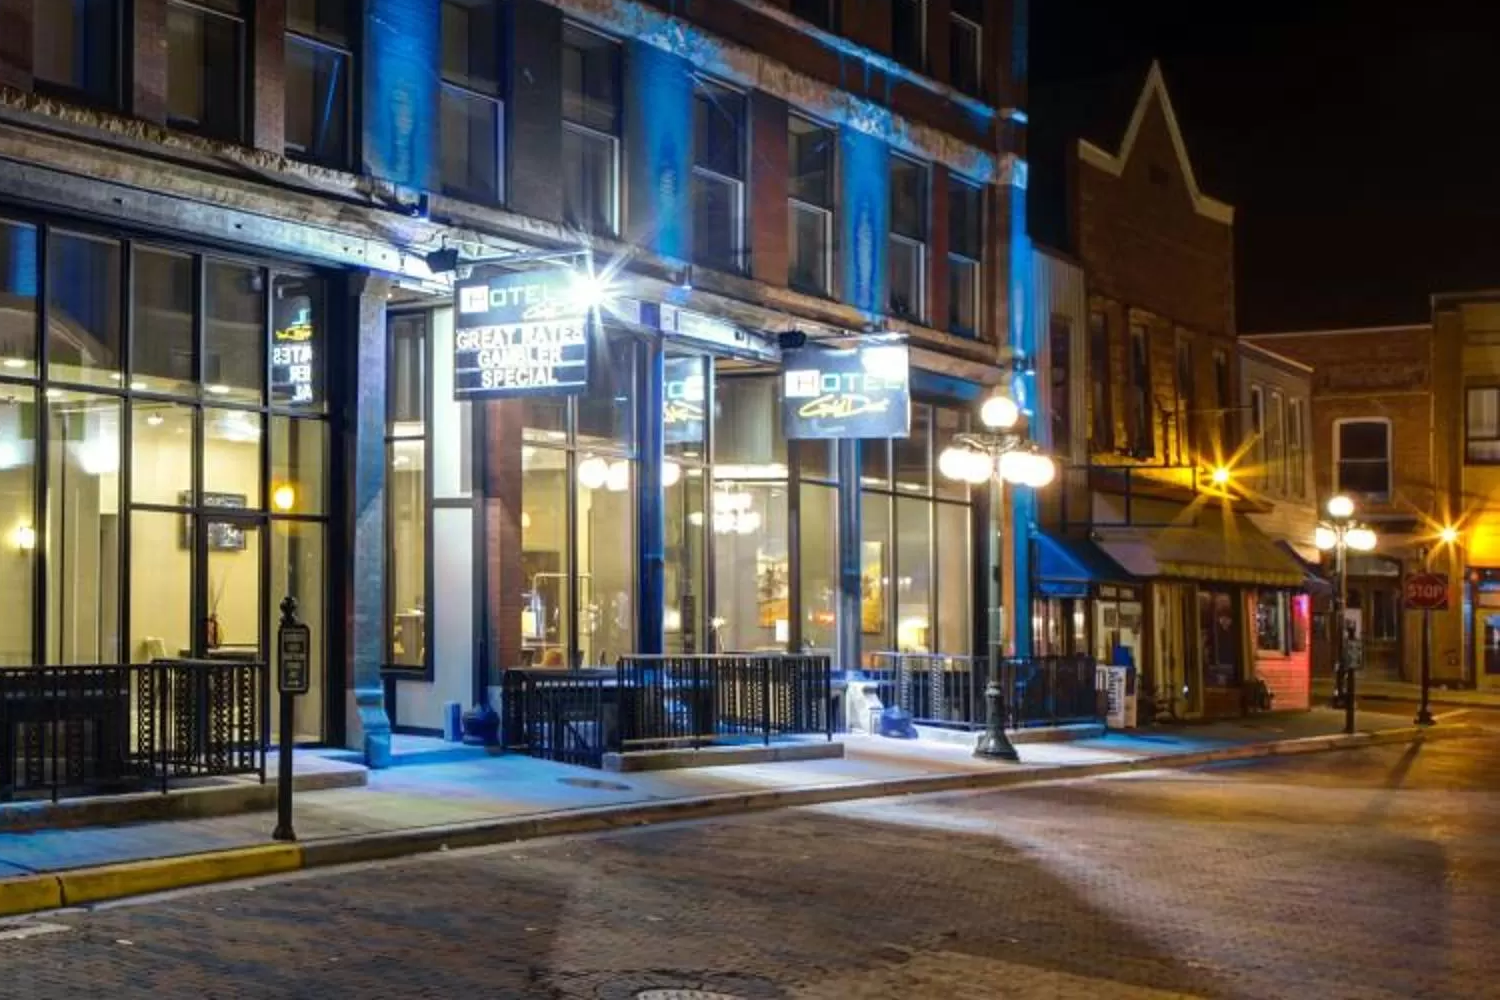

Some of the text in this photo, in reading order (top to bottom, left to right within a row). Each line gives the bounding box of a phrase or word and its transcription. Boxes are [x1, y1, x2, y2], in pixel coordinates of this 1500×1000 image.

[457, 326, 519, 351] GREAT
[481, 366, 558, 389] SPECIAL
[1407, 583, 1444, 598] STOP
